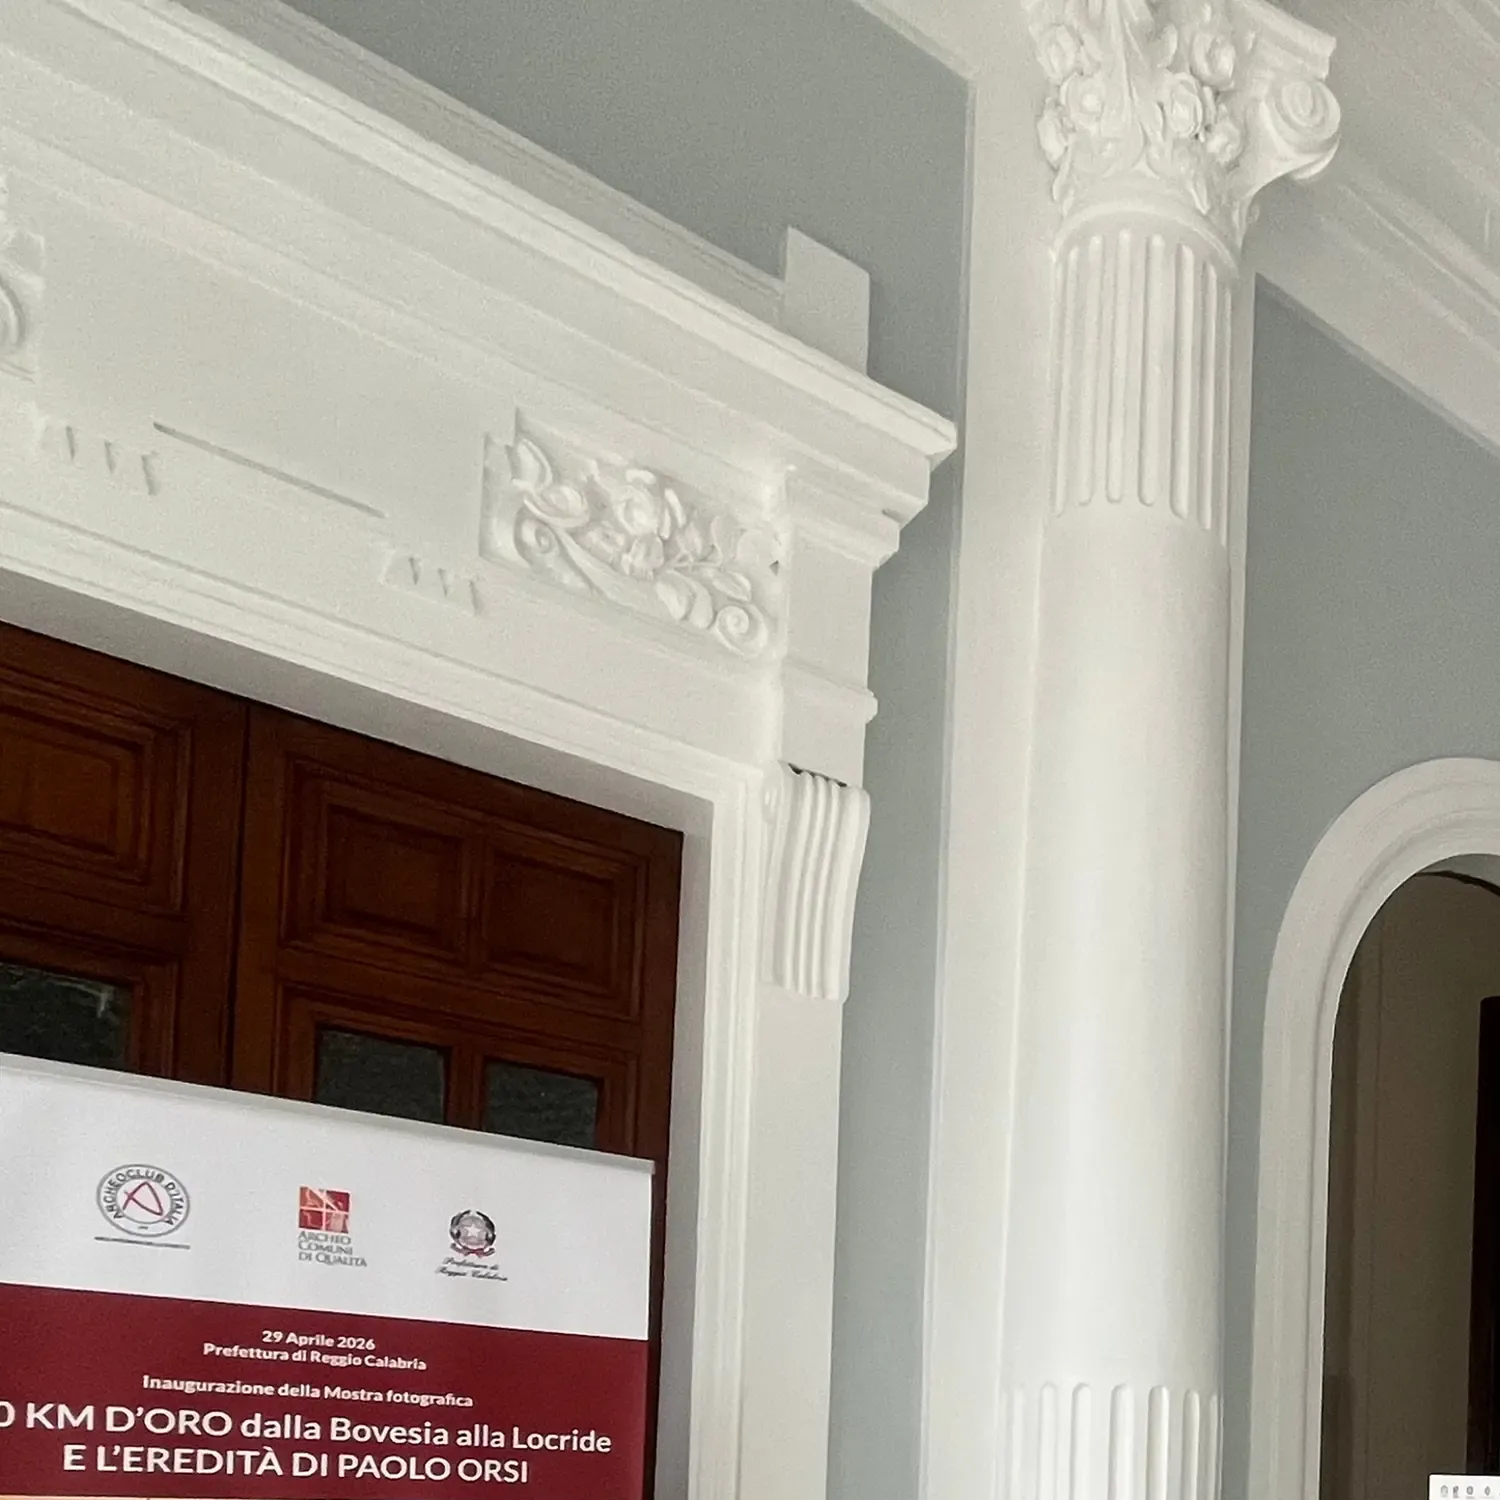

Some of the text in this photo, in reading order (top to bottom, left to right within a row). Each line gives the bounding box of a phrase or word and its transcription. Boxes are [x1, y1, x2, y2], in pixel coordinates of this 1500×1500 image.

[299, 1231, 352, 1245] ARCHEO
[299, 1240, 353, 1255] COMUNI
[299, 1251, 313, 1261] DI
[263, 1331, 375, 1350] 29 Aprile 2026
[204, 1343, 426, 1369] Prefettura di Reggio Calabria
[144, 1375, 473, 1406] Inaugurazione della Mostra fotografica
[27, 1403, 611, 1452] KM D'ORO dalla Bovesia alla Locride
[64, 1445, 527, 1482] E L'EREDITÀ DI PAOLO ORSI
